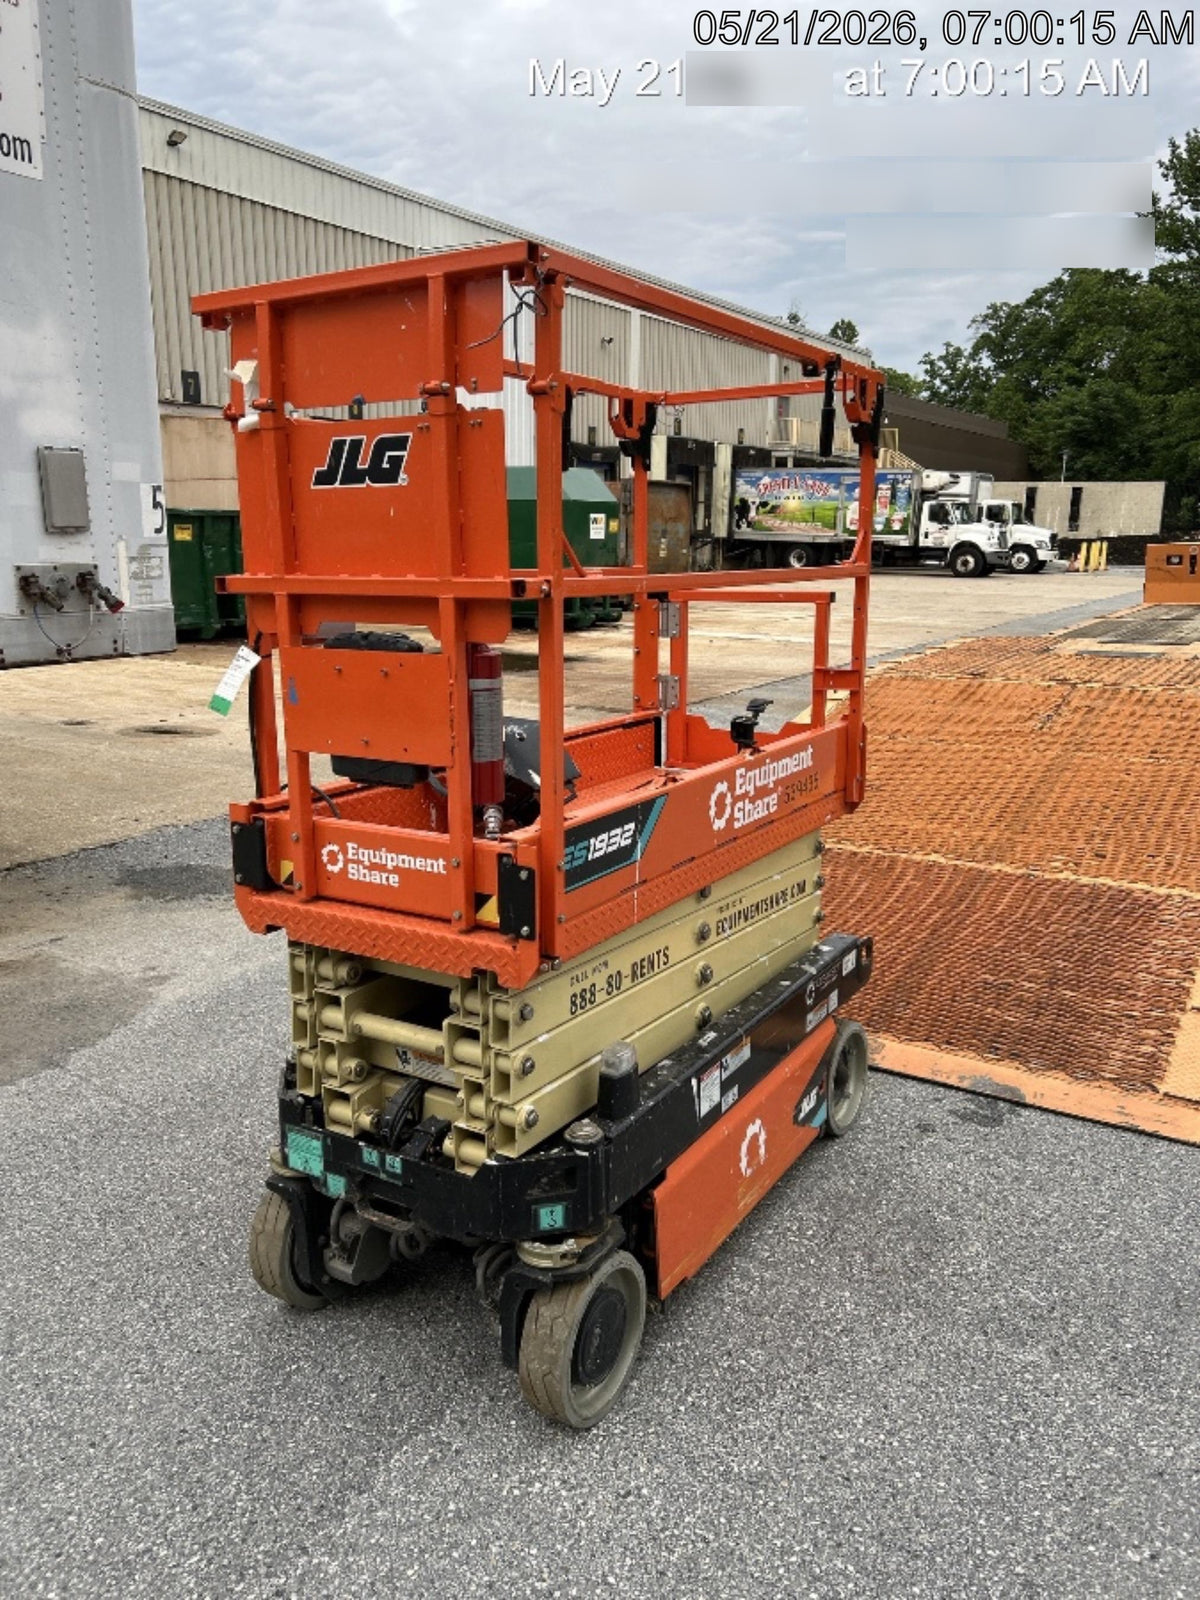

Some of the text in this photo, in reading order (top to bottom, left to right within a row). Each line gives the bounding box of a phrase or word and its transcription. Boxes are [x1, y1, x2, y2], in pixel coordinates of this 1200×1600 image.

[311, 432, 413, 489] JLG
[735, 744, 813, 798] Equipment
[734, 792, 778, 829] Share
[346, 842, 447, 874] Equipment
[348, 863, 399, 887] Share
[570, 946, 670, 1016] 888-80-RENTS
